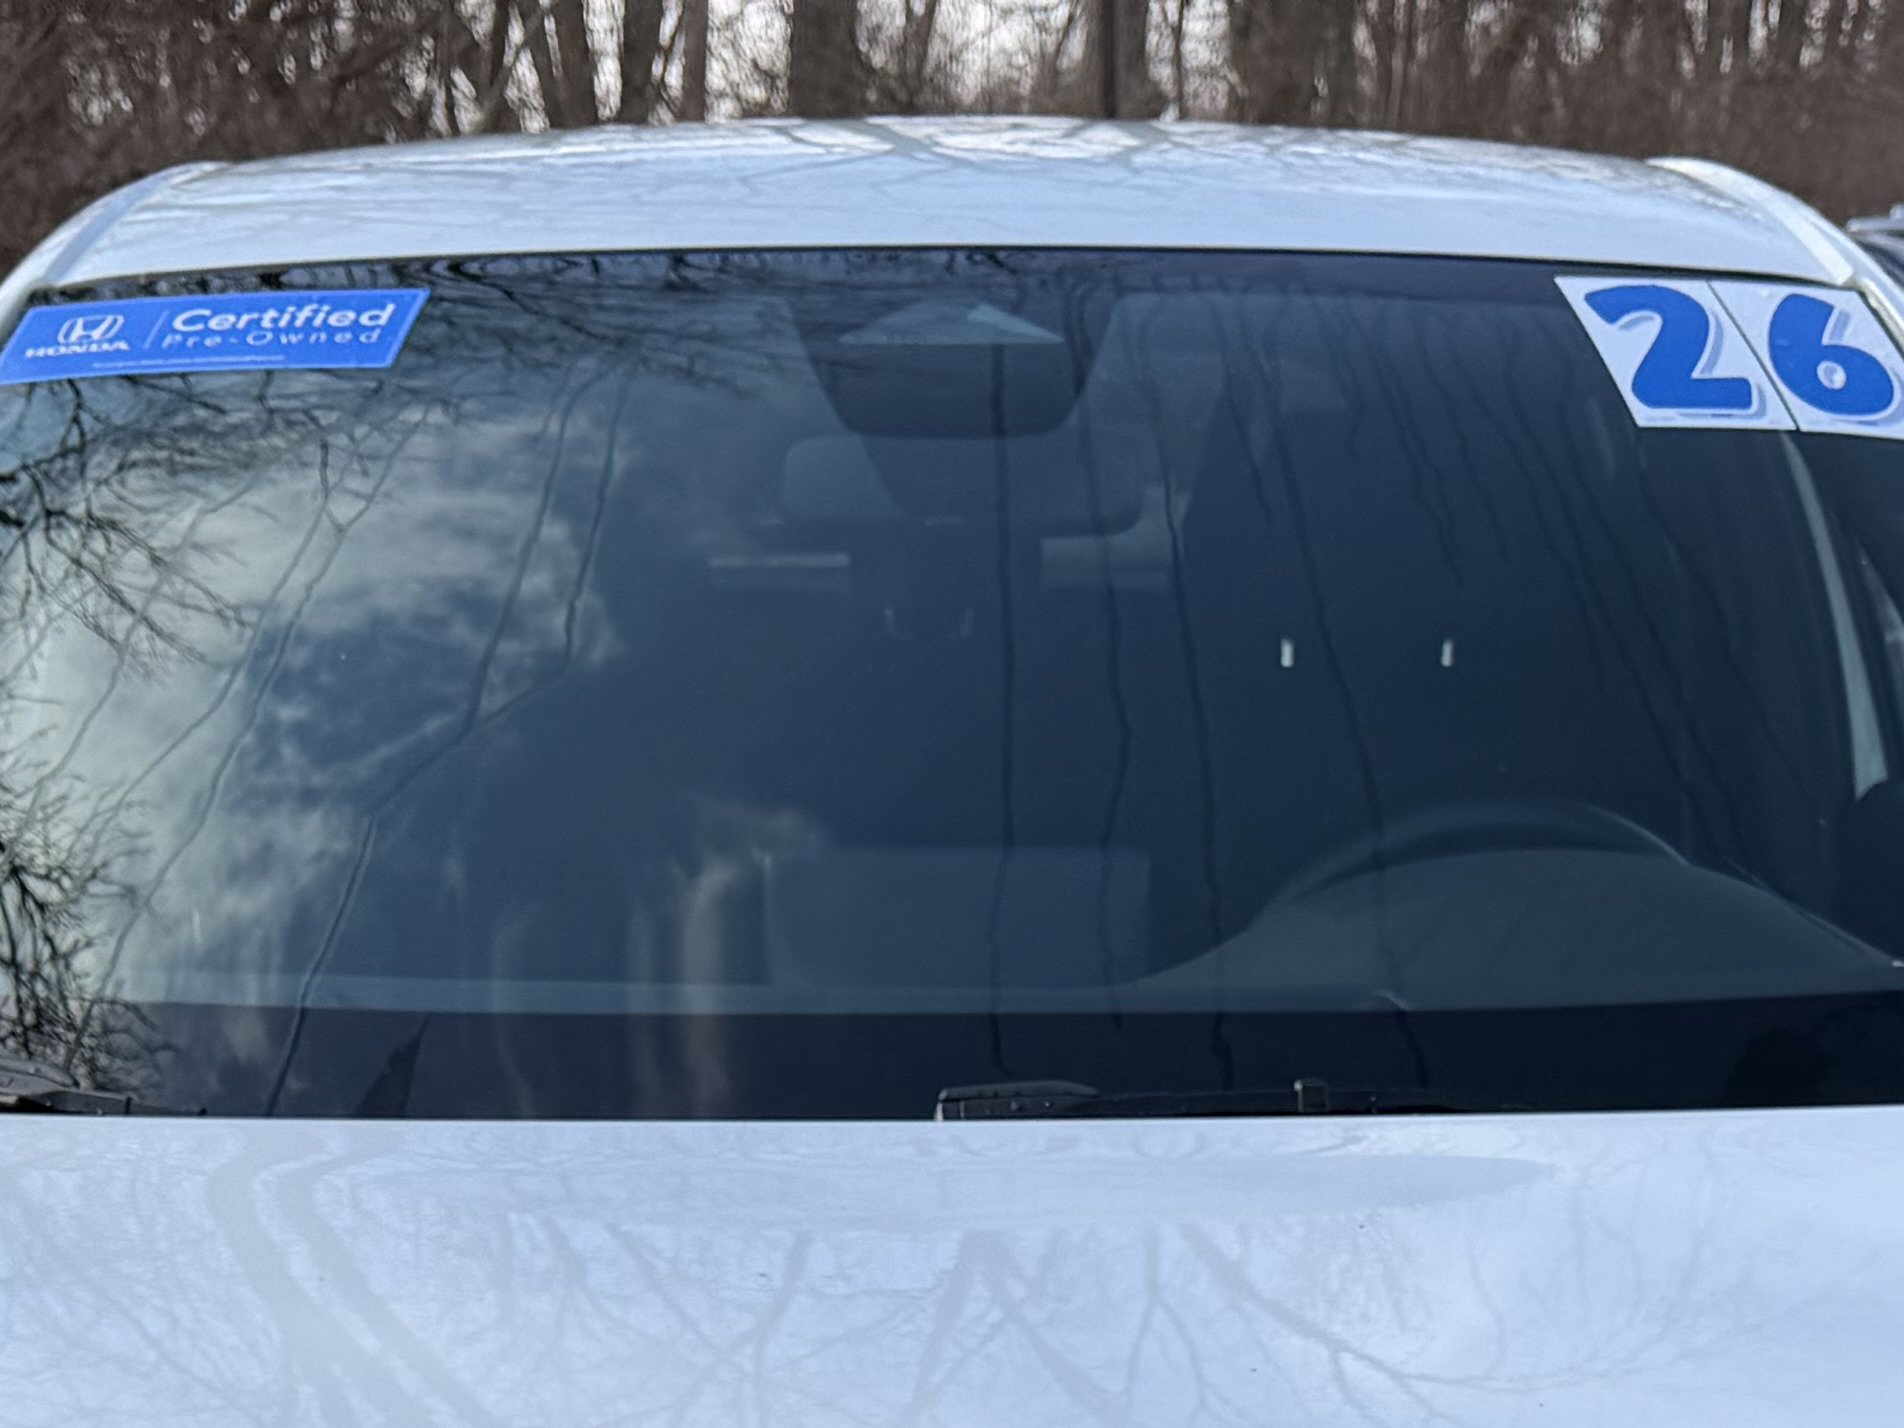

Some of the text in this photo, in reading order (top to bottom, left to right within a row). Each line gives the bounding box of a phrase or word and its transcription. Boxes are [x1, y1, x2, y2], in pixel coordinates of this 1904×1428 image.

[172, 303, 396, 332] Certified
[161, 328, 382, 348] Pre-Owned
[1584, 284, 1902, 420] 26
